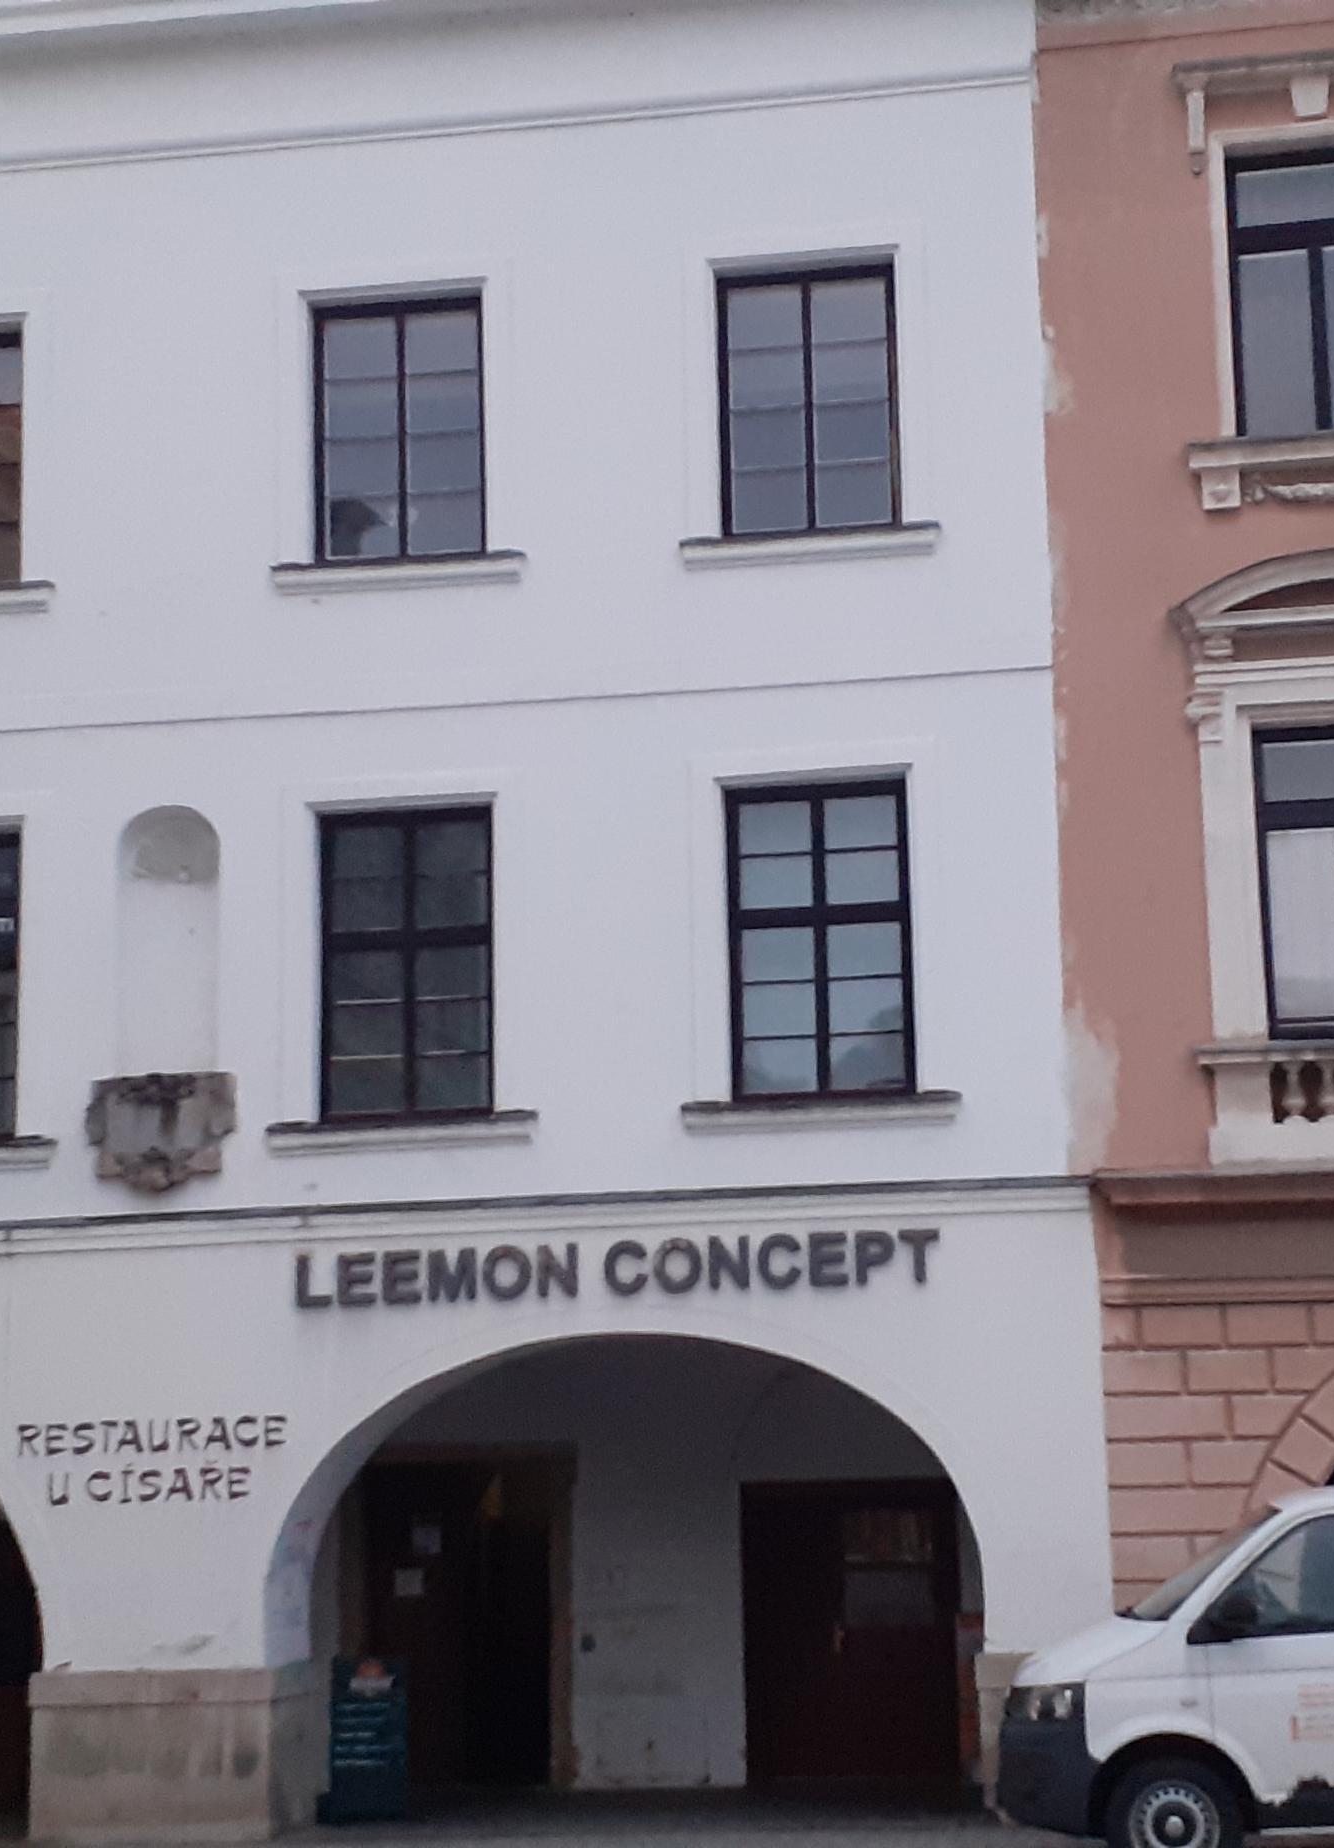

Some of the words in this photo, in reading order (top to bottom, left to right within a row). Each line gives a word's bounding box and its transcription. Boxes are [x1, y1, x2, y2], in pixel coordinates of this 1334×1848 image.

[294, 1241, 578, 1309] LEEMON
[604, 1228, 940, 1298] CONCEPT
[16, 1415, 287, 1456] RESTAURACE
[48, 1472, 69, 1505] U
[86, 1460, 251, 1503] CÍSAŘE
